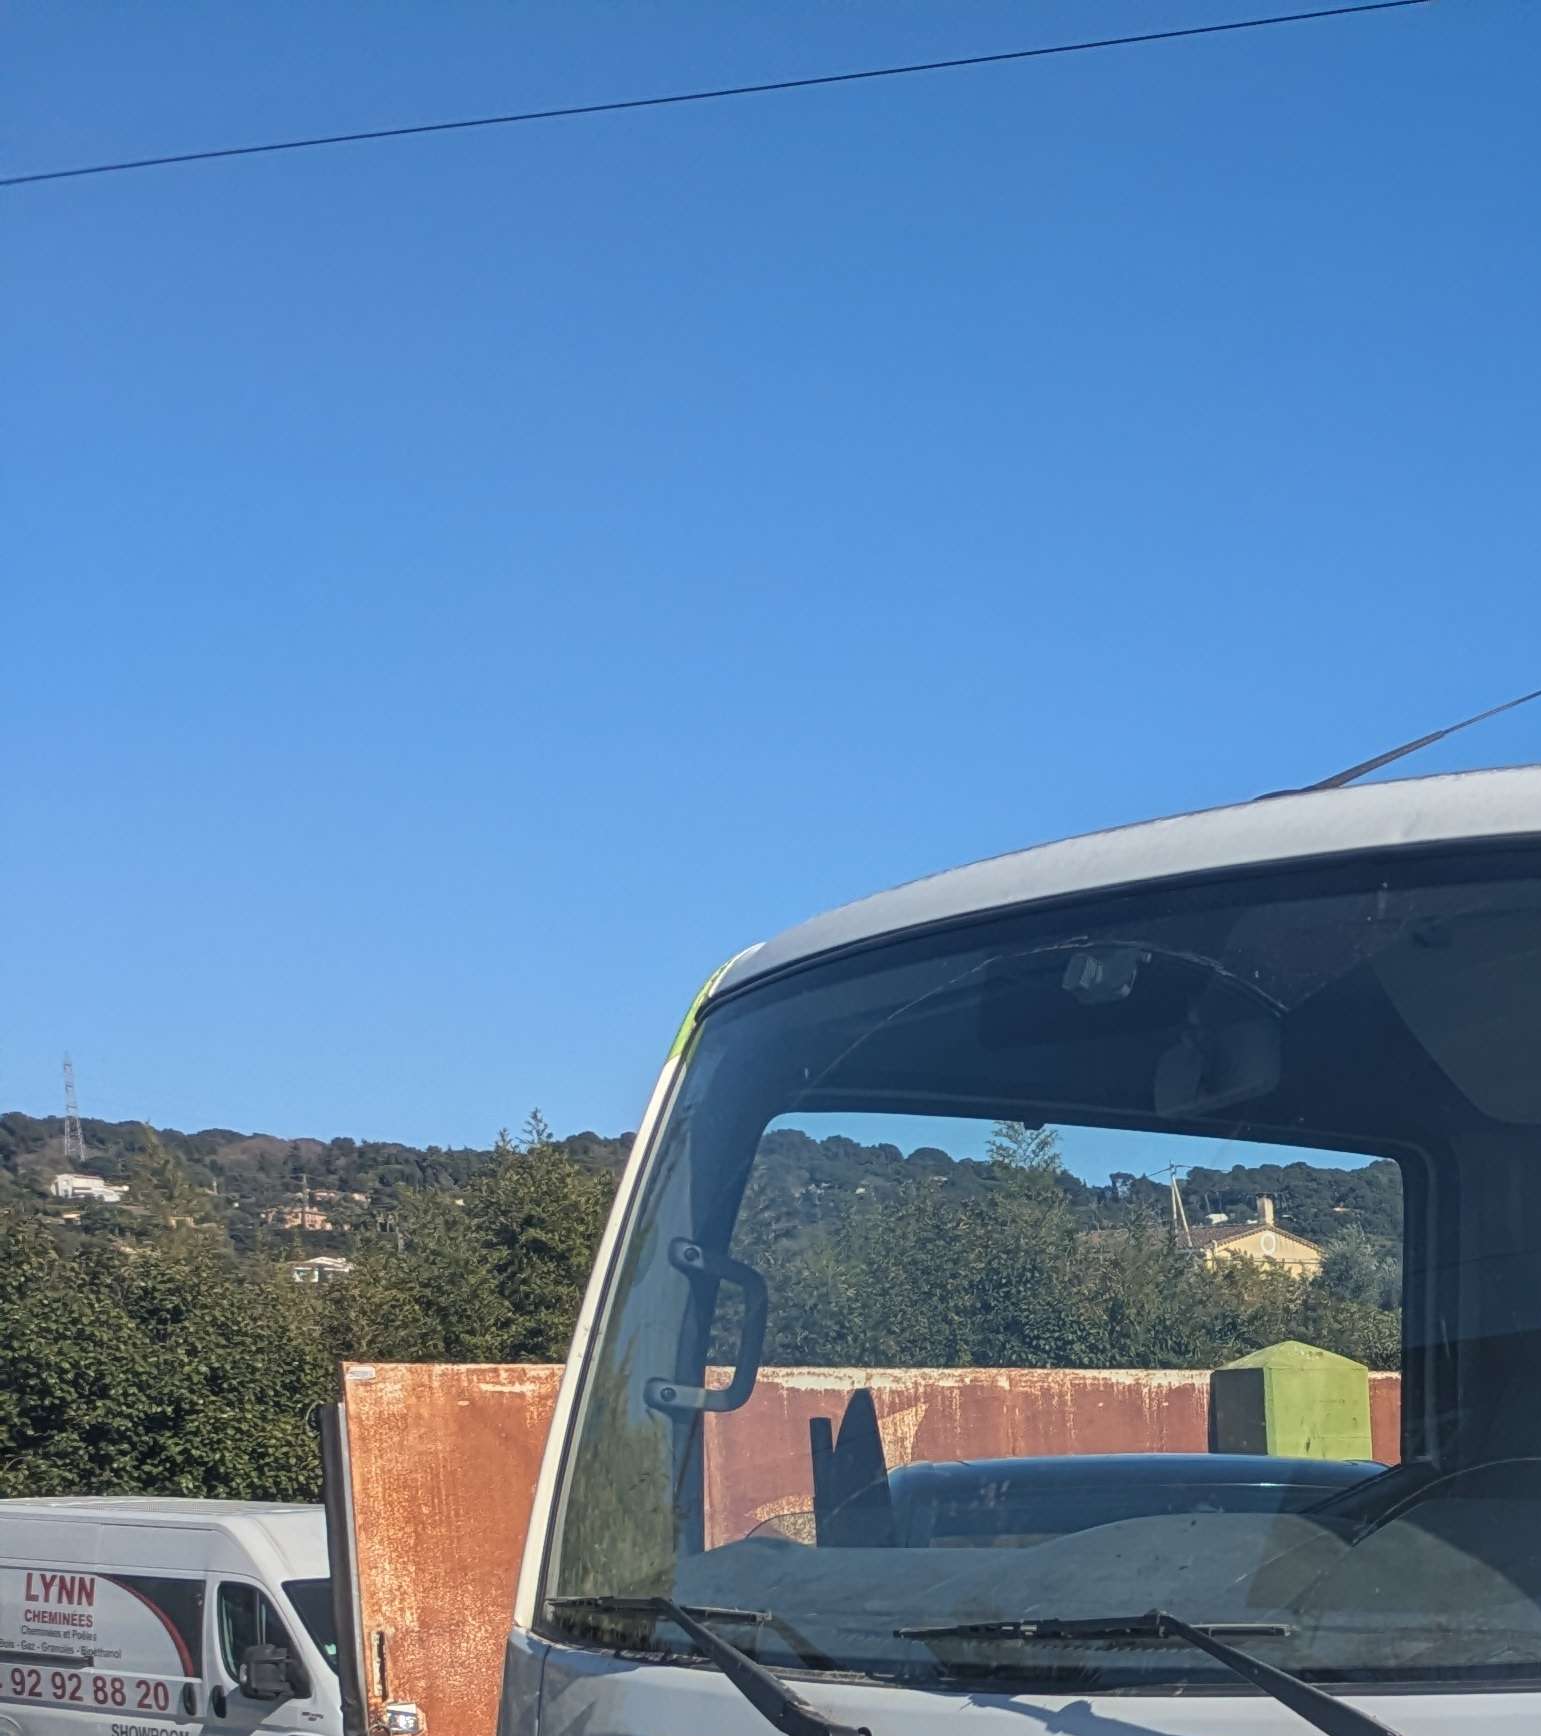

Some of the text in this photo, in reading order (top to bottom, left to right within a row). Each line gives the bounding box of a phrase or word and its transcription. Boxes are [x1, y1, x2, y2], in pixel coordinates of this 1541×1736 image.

[25, 1572, 95, 1607] LYNN
[11, 1668, 169, 1711] 92 92 88 20
